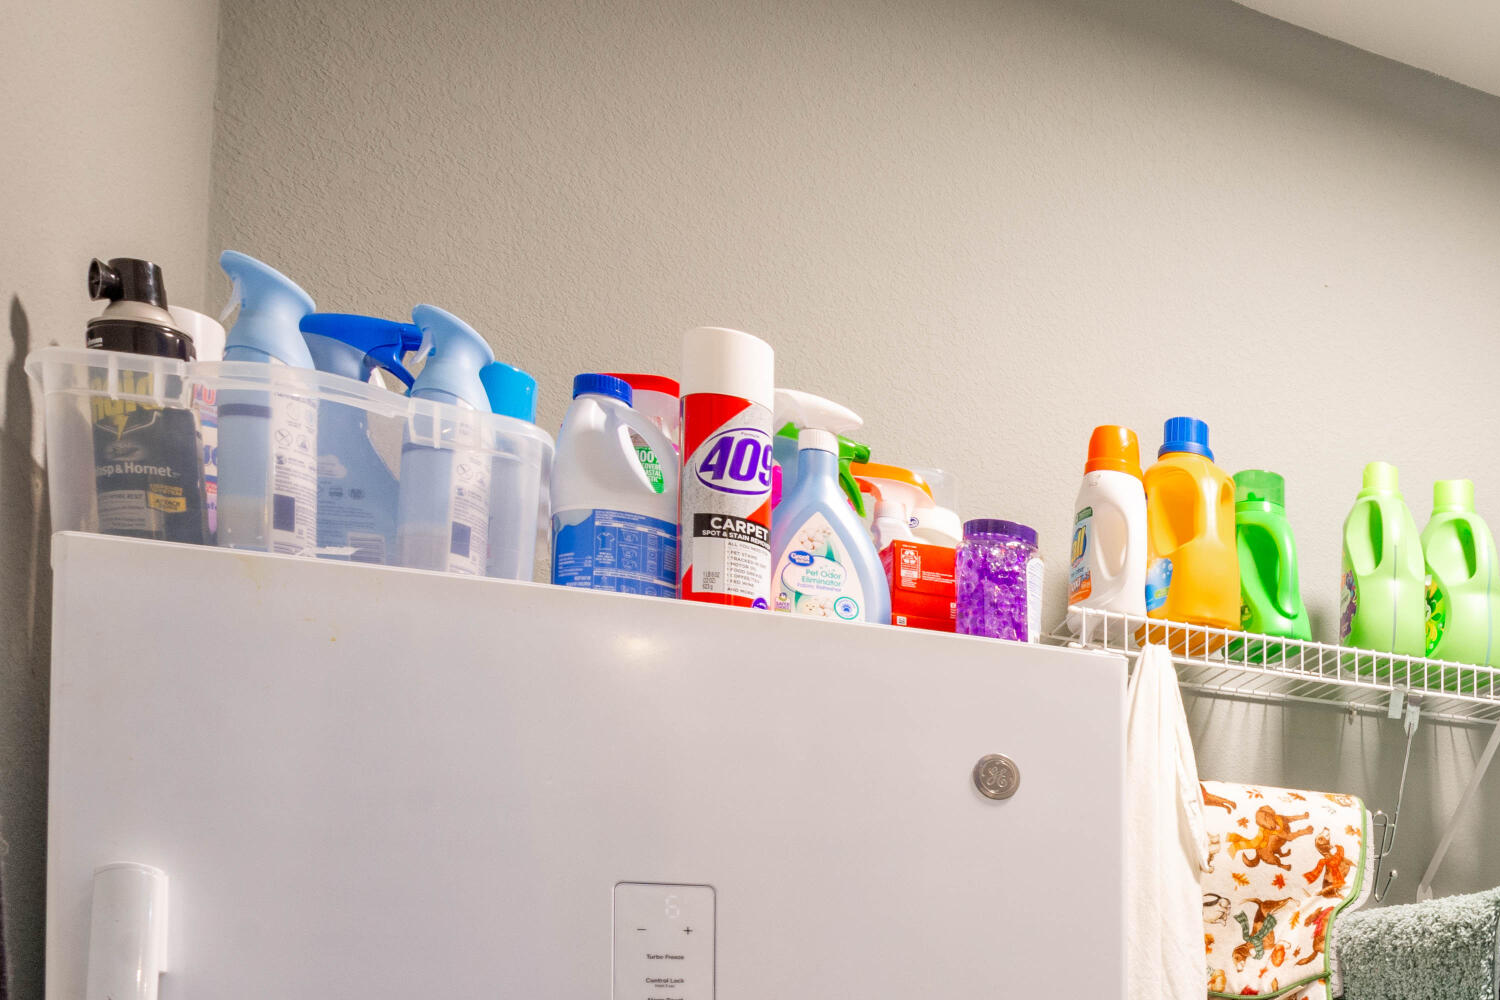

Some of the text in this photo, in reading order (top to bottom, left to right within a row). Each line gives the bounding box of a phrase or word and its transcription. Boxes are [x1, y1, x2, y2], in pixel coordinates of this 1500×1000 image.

[699, 435, 772, 488] 409
[116, 463, 122, 474] &
[124, 461, 172, 478] Hornet
[711, 516, 769, 541] CARPET
[729, 532, 749, 541] STAIN
[805, 568, 841, 580] Pet Odor
[801, 575, 841, 587] Eliminator
[646, 953, 664, 961] Turbo
